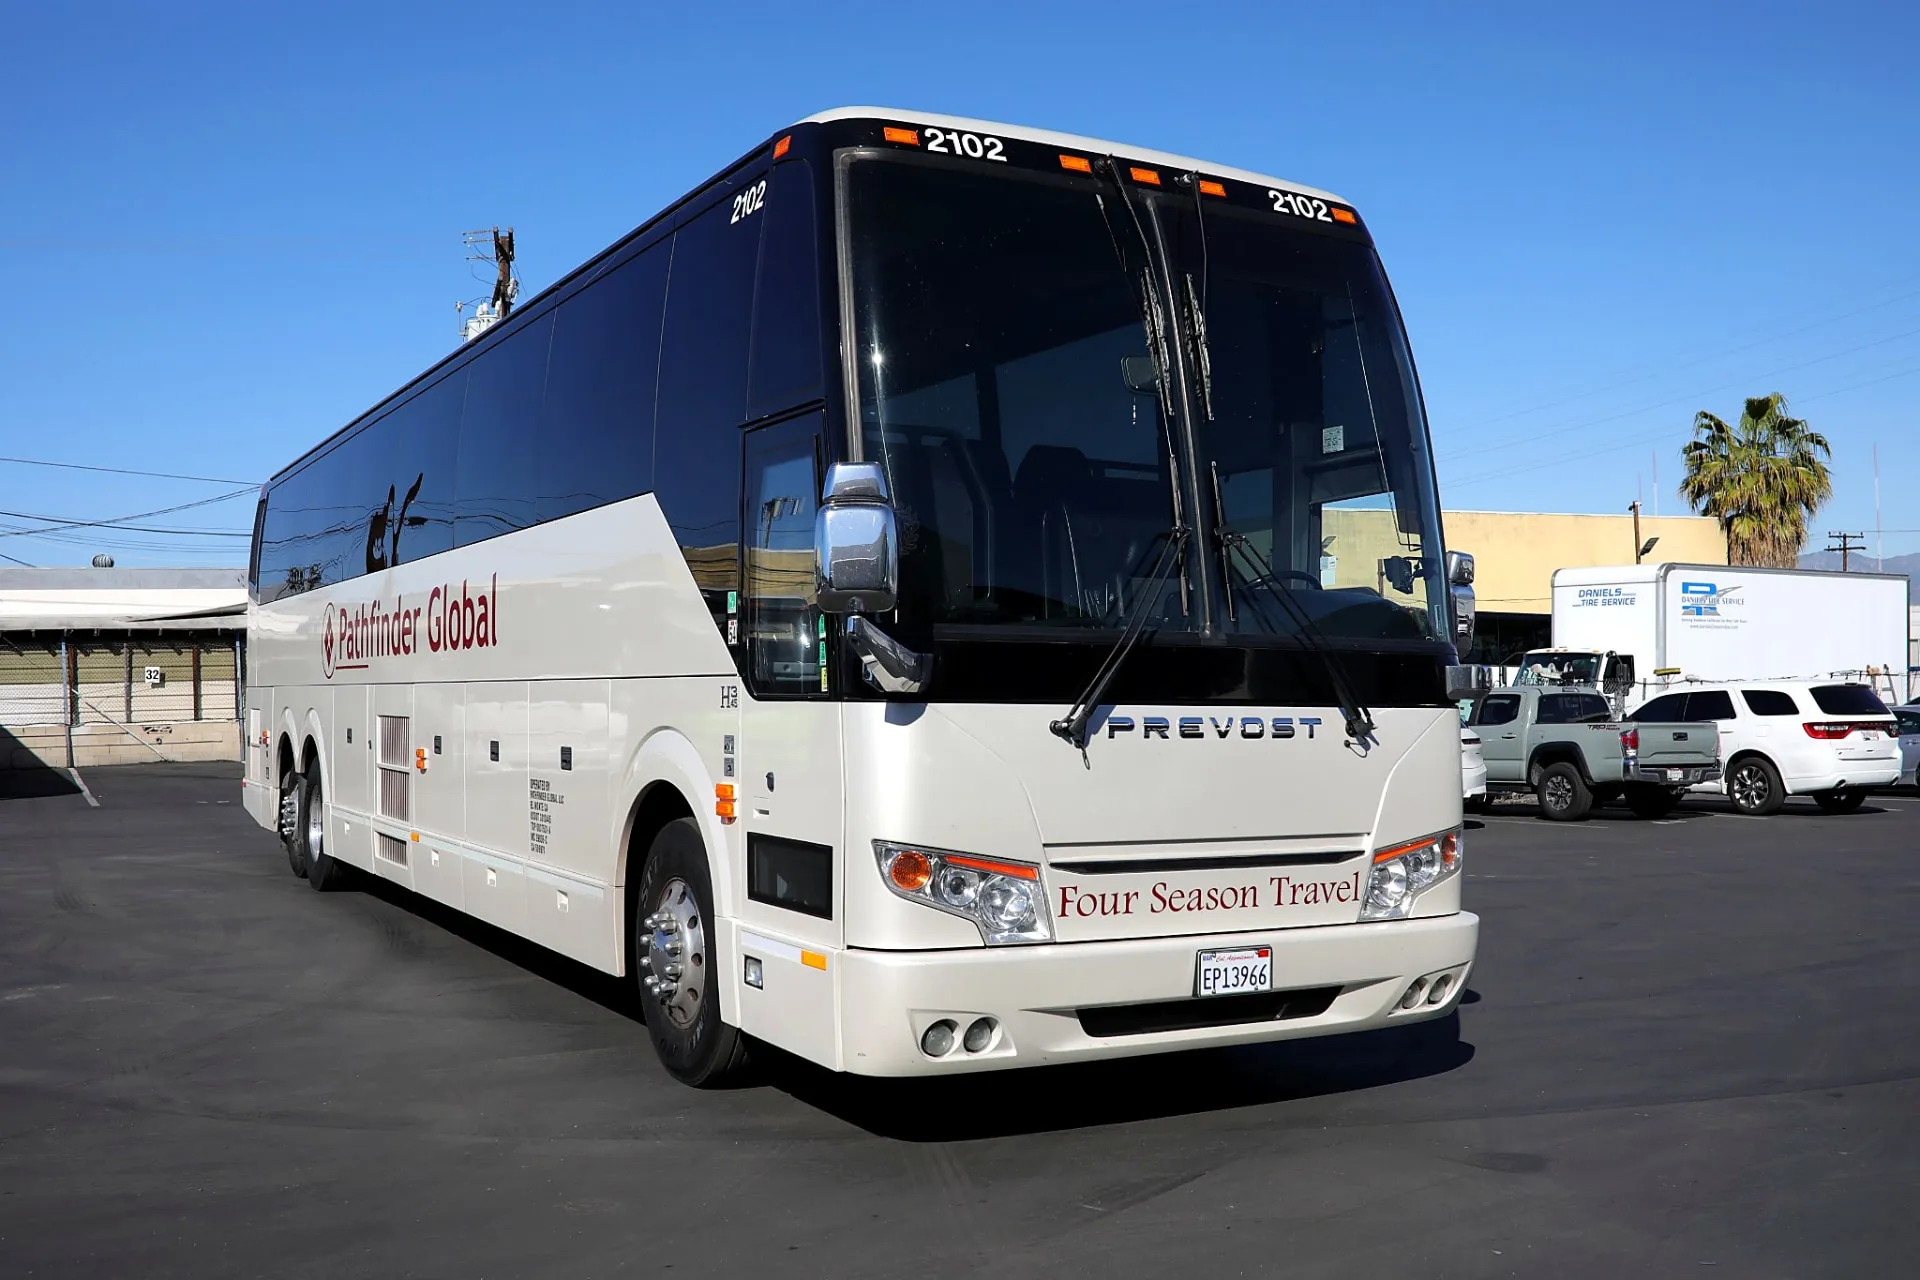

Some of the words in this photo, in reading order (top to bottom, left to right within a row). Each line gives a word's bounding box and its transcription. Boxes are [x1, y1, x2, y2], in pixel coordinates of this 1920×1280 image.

[924, 128, 1008, 162] 2102
[730, 180, 766, 224] 2102
[1268, 190, 1333, 223] 2102
[1578, 588, 1622, 598] DANIELS
[1581, 598, 1599, 606] TIRE
[1601, 597, 1636, 606] SERVICE
[339, 594, 421, 660] Pathfinder
[428, 572, 497, 653] Global
[146, 669, 159, 680] 32
[1107, 716, 1323, 739] PREVOST
[1058, 885, 1139, 918] Four
[1150, 882, 1260, 914] Season
[1269, 871, 1361, 907] Travel
[1203, 964, 1267, 990] EP13966
